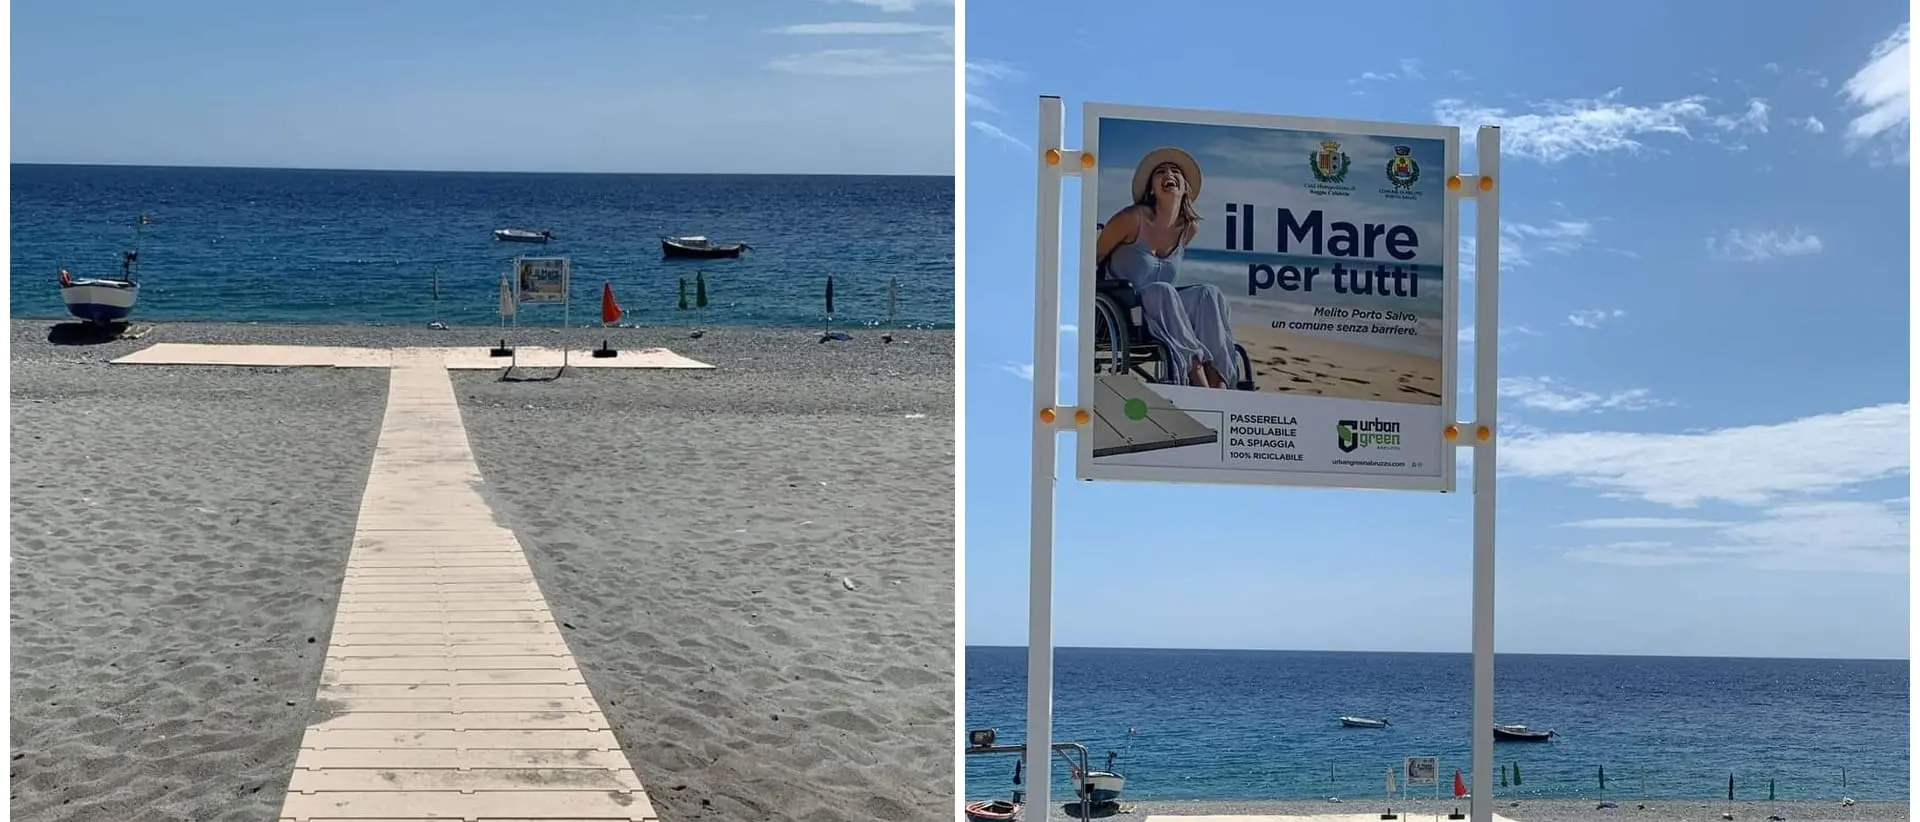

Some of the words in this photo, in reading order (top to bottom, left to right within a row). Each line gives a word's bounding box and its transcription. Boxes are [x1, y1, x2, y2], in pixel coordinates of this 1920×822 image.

[1226, 203, 1254, 250] il
[1277, 208, 1419, 260] Mare
[1248, 262, 1320, 296] per
[1332, 263, 1419, 298] tutti
[1314, 307, 1349, 319] Melito
[1351, 309, 1382, 320] Porto
[1385, 310, 1418, 323] Salvo,
[1271, 320, 1286, 329] un
[1288, 321, 1334, 331] comune
[1336, 323, 1368, 333] senza
[1371, 324, 1418, 336] barriere.
[1230, 414, 1298, 425] PASSERELLA
[1359, 417, 1400, 432] urban
[1230, 426, 1297, 437] MODULABILE
[1230, 438, 1245, 446] DA
[1247, 439, 1295, 449] SPIAGGIA
[1359, 433, 1400, 448] green
[1230, 451, 1251, 459] 100%
[1253, 452, 1305, 461] RICICLABILE
